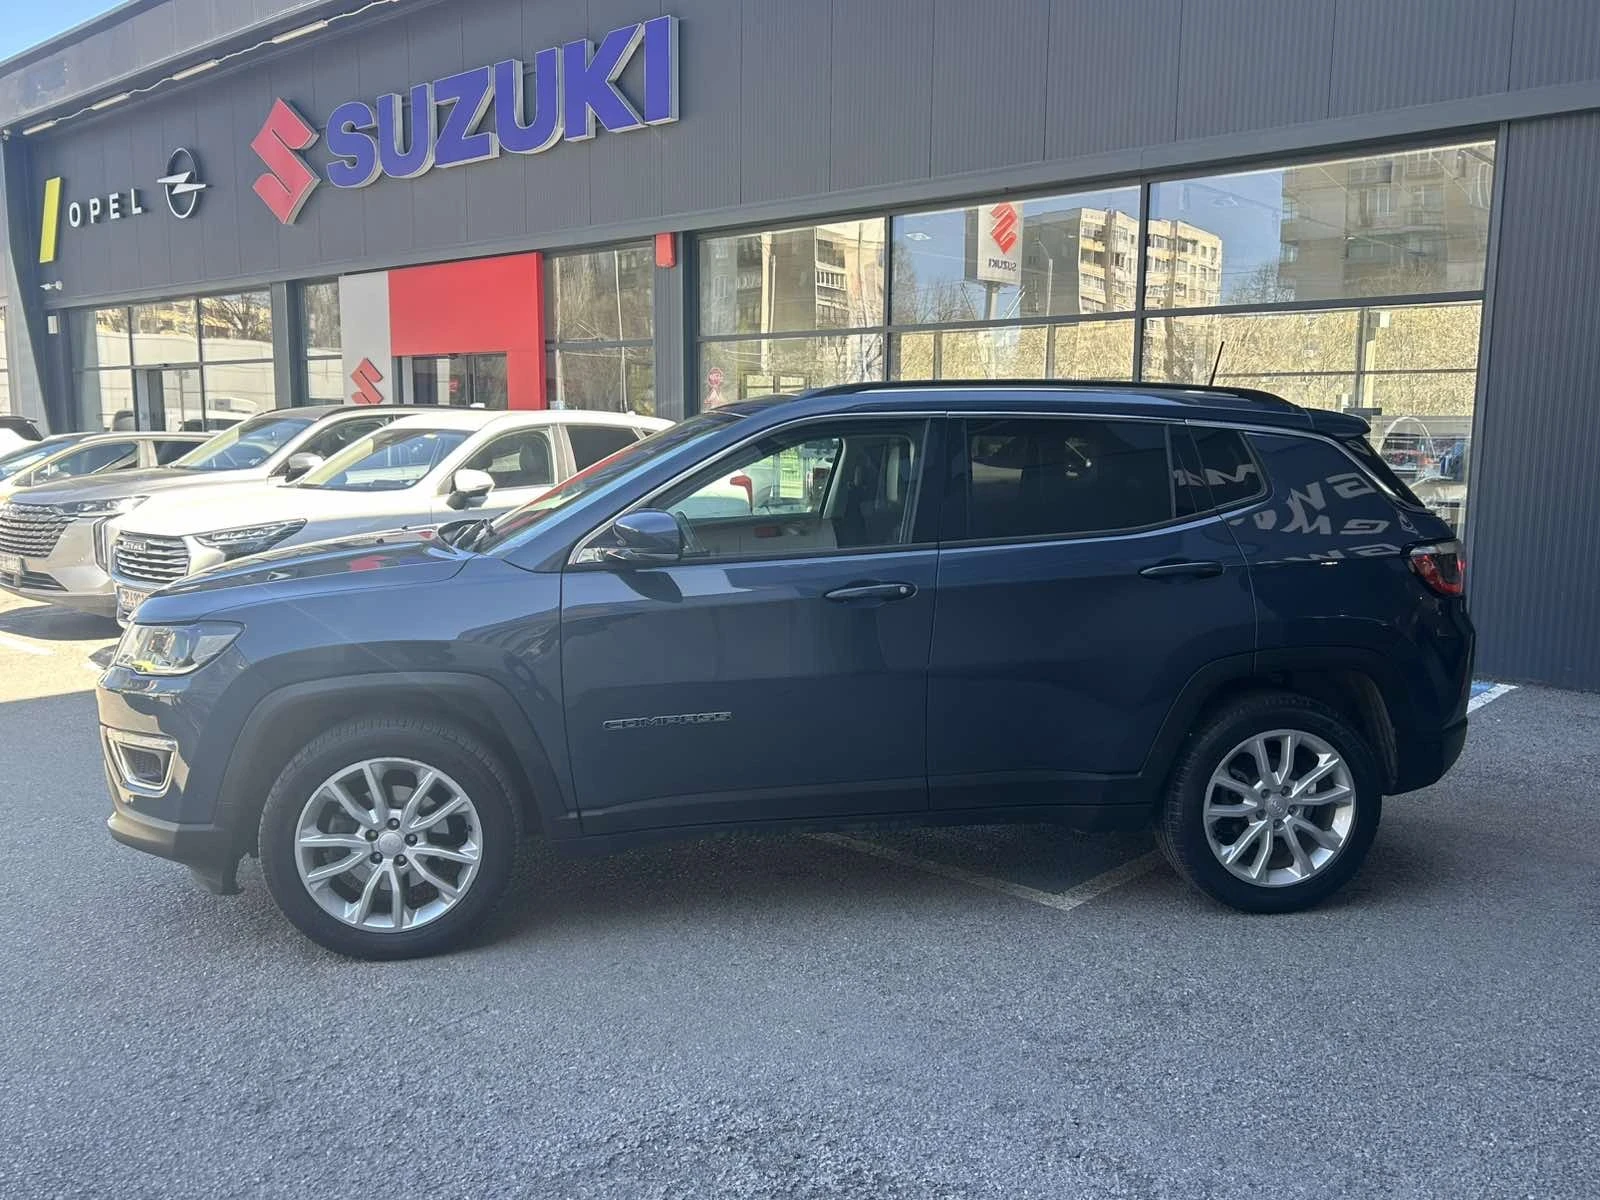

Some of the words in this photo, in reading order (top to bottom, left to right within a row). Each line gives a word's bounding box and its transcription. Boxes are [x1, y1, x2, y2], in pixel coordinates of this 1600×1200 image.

[326, 15, 679, 188] SUZUKI
[69, 188, 142, 227] OPEL
[602, 711, 732, 729] COMPASS
